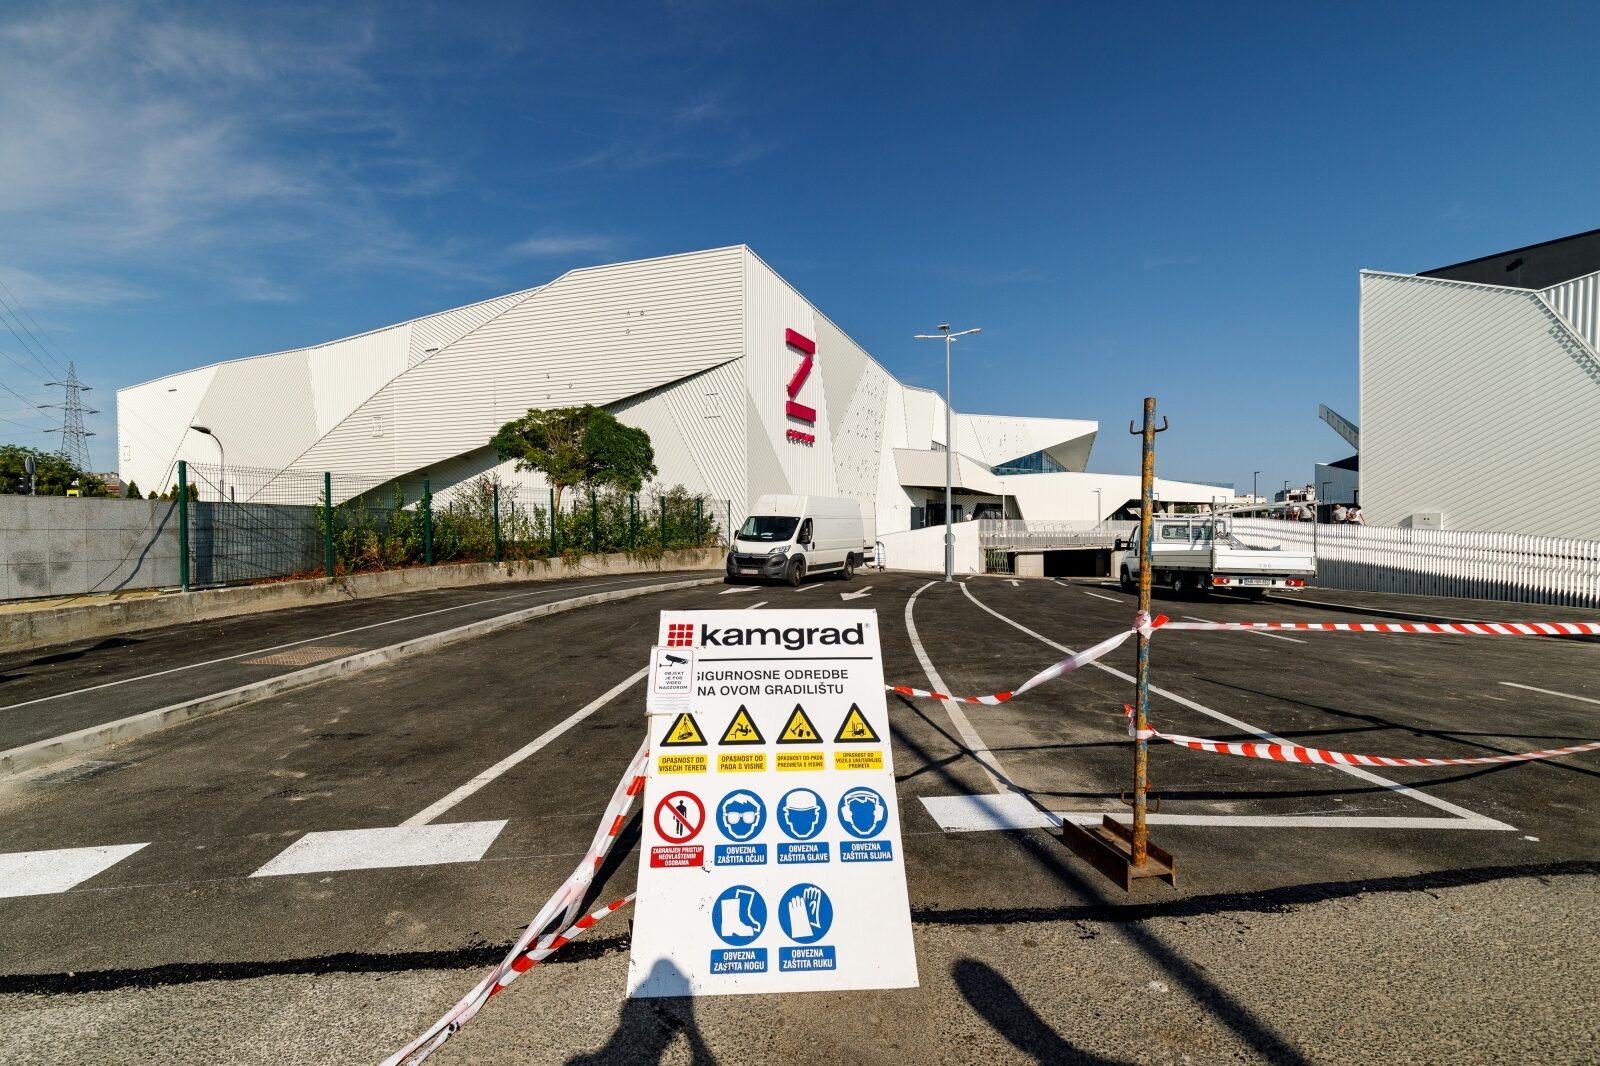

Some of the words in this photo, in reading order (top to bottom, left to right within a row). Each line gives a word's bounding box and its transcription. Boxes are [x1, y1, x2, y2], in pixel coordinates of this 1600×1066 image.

[786, 328, 816, 422] Z
[700, 622, 864, 650] kamgrad
[784, 670, 848, 680] ODREDBE
[698, 686, 716, 696] NA
[720, 685, 760, 696] OVOM
[764, 682, 844, 694] GRADILIŠTU
[718, 855, 744, 864] ZAŠTITA
[746, 854, 764, 863] OČIJU
[780, 853, 805, 861] ZAŠTITA
[842, 851, 868, 860] ZAŠTITA
[723, 951, 755, 960] OBVEZNA
[791, 949, 824, 958] OBVEZNA
[744, 961, 764, 970] NOGU
[783, 958, 811, 969] ZAŠTITA
[813, 959, 832, 967] RUKU
